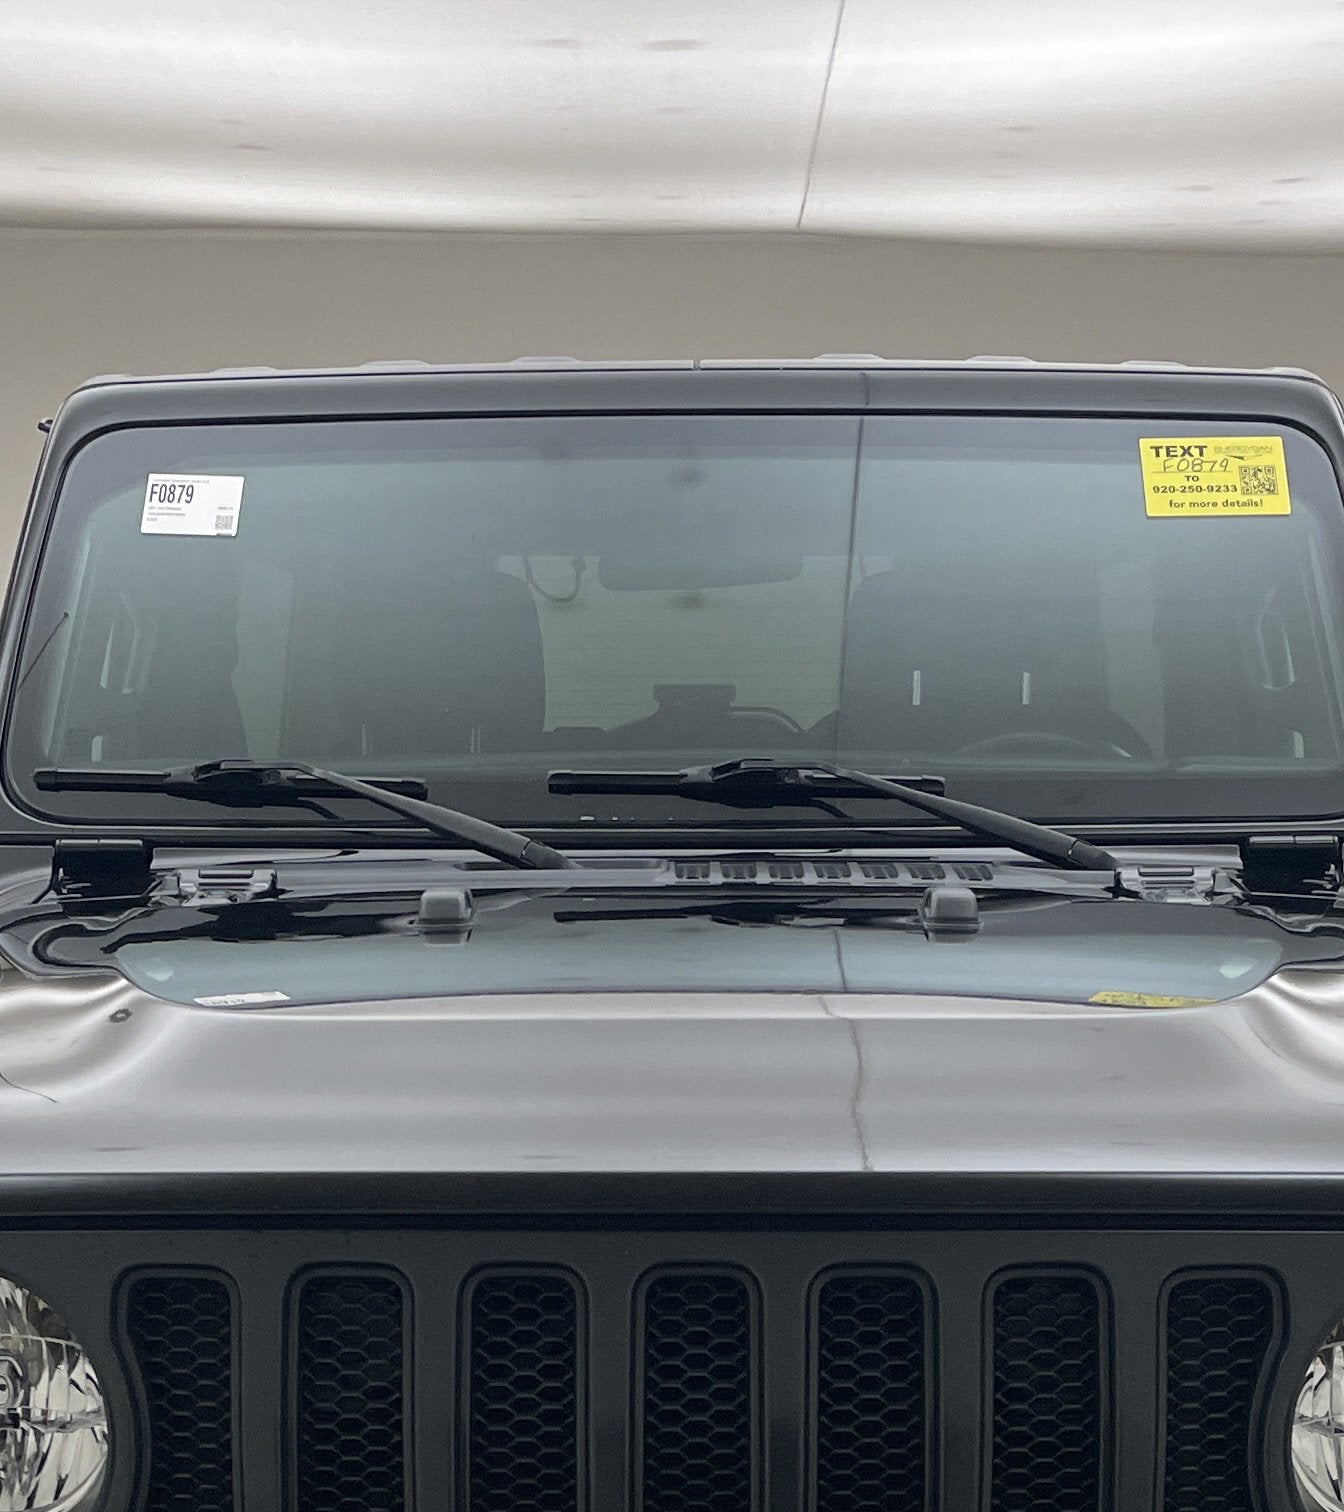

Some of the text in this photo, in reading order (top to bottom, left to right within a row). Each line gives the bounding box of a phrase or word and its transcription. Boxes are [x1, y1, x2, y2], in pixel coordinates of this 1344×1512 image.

[1150, 445, 1208, 458] TEXT
[1184, 475, 1200, 483] TO
[149, 483, 195, 504] F0879
[1152, 484, 1238, 494] 920-250-9233
[1169, 499, 1186, 508] for
[1222, 499, 1263, 508] details!
